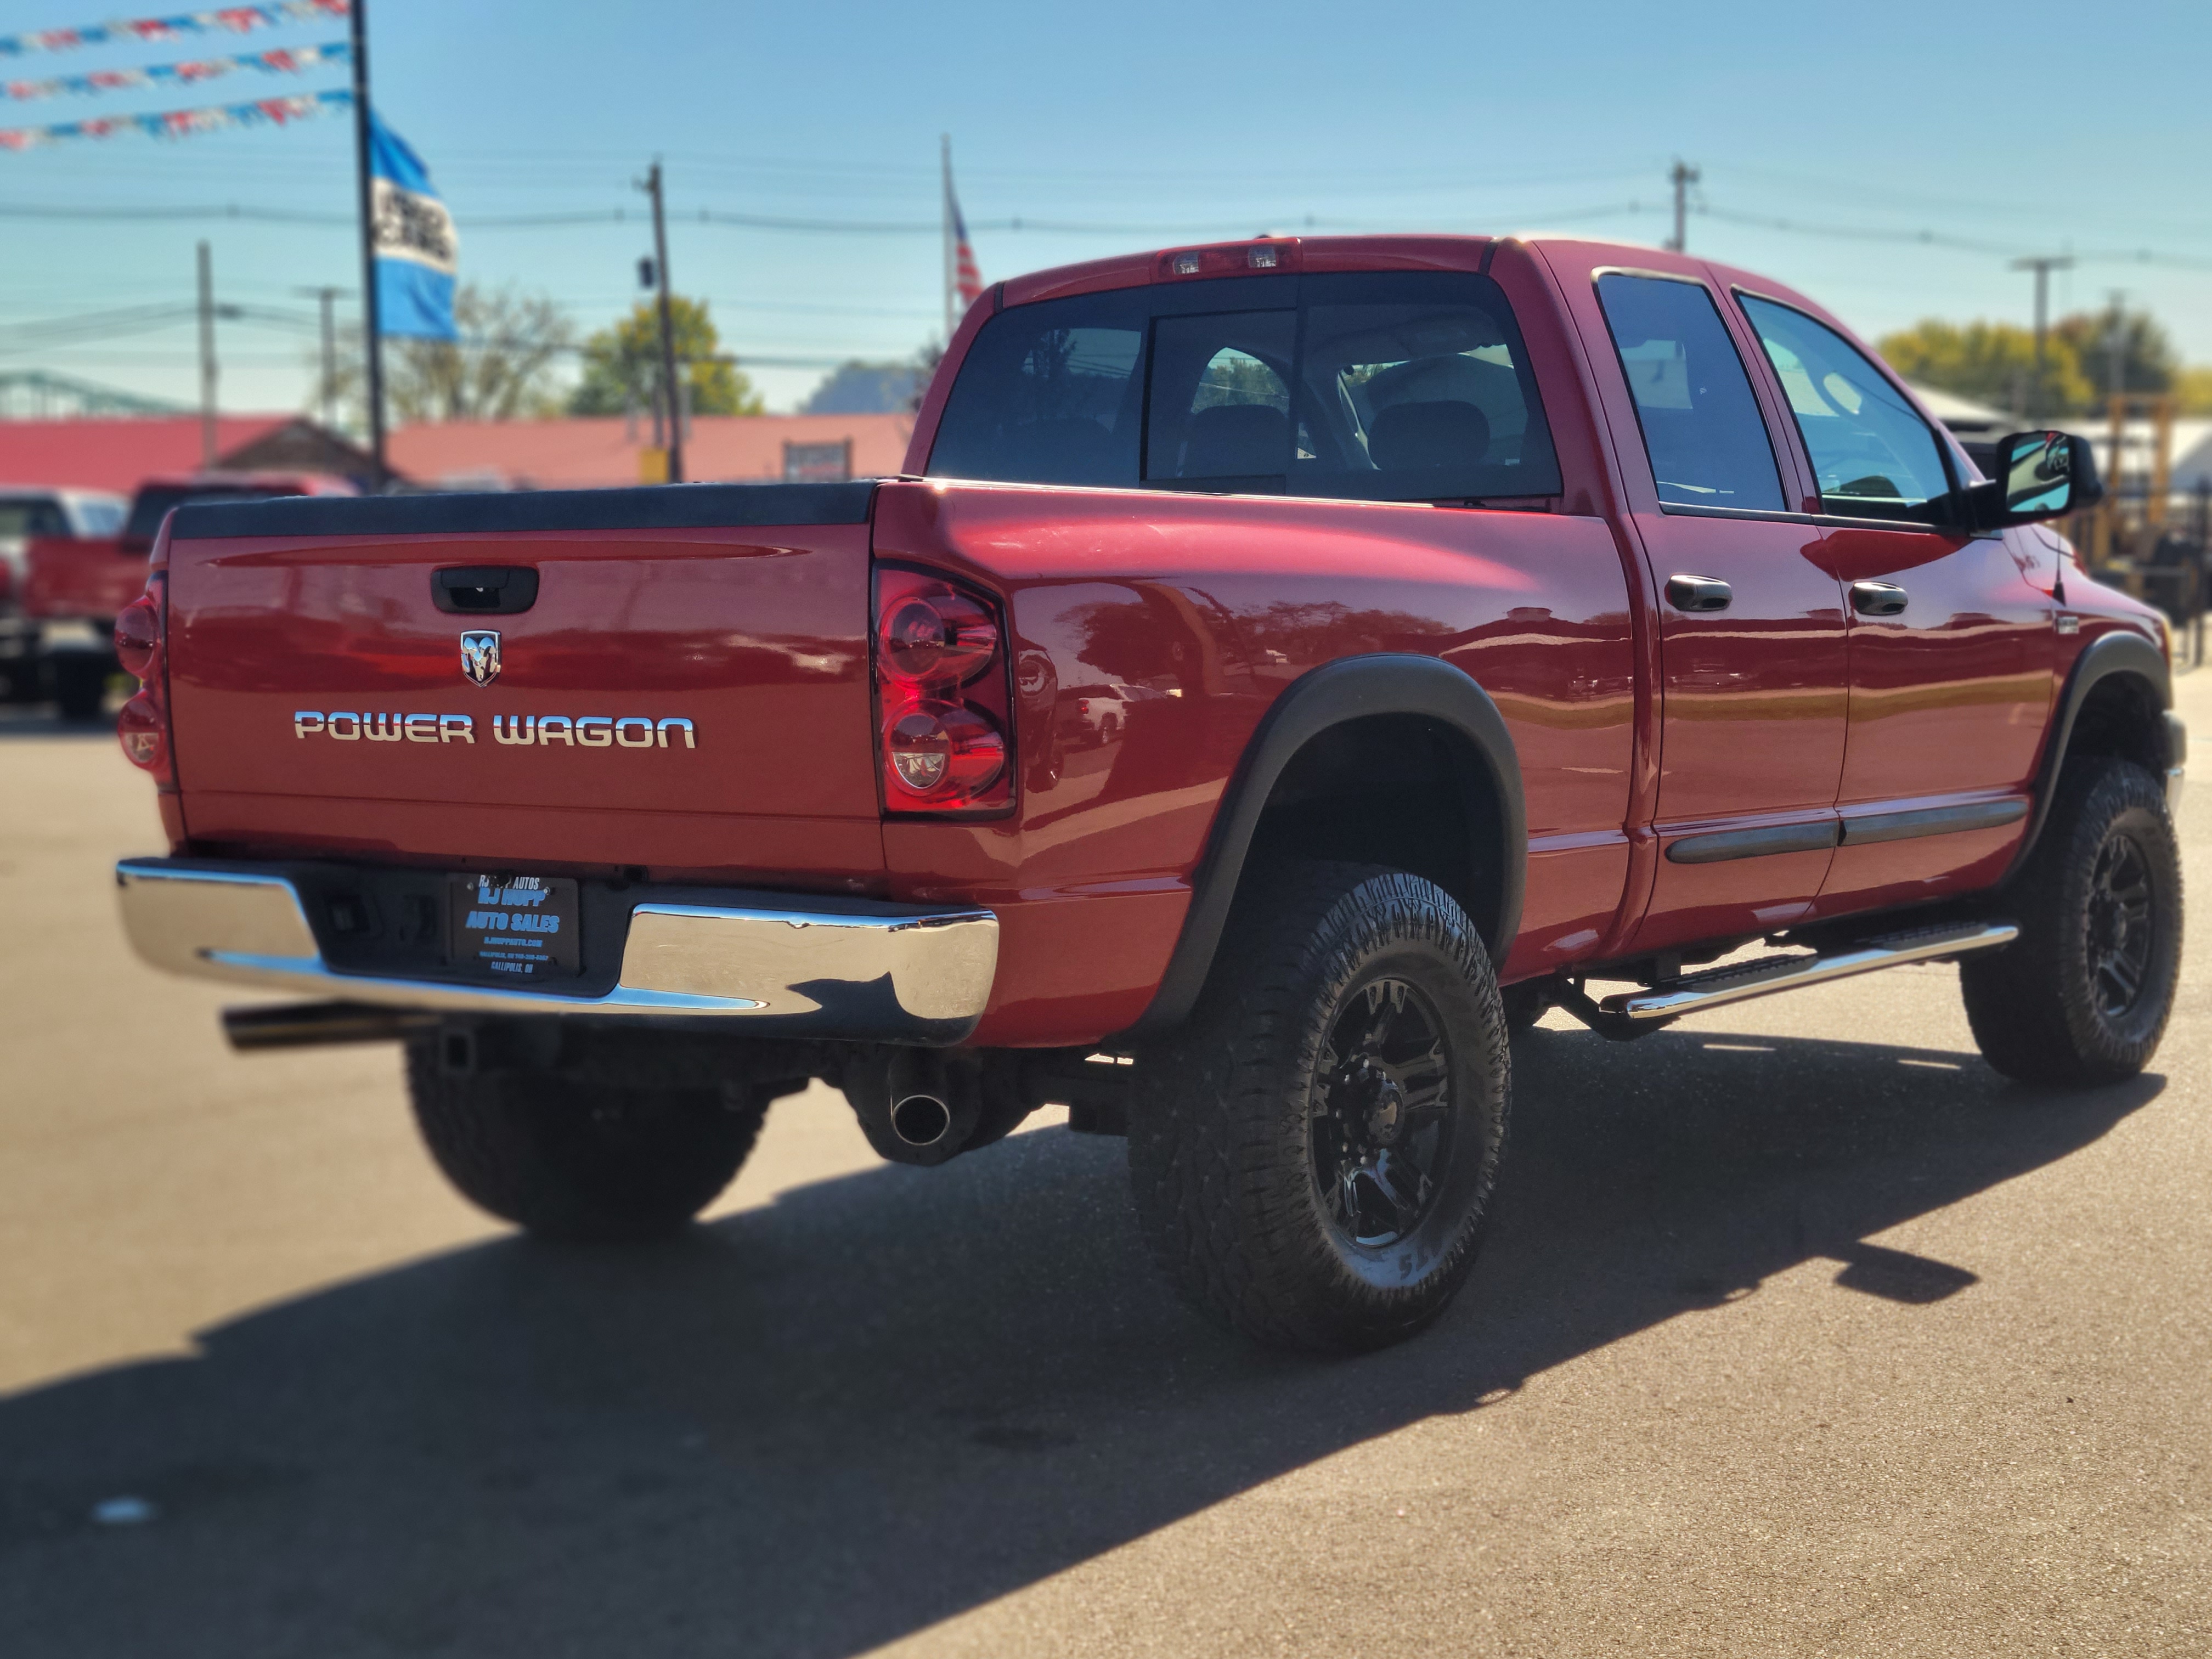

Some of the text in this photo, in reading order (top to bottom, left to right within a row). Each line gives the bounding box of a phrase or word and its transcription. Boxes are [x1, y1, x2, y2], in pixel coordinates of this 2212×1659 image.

[295, 711, 696, 749] POWER WAGON
[512, 876, 540, 890] AUTOS
[478, 887, 546, 906] RJ HUPP
[466, 911, 560, 933] AUTO SALES
[524, 964, 533, 973] OH
